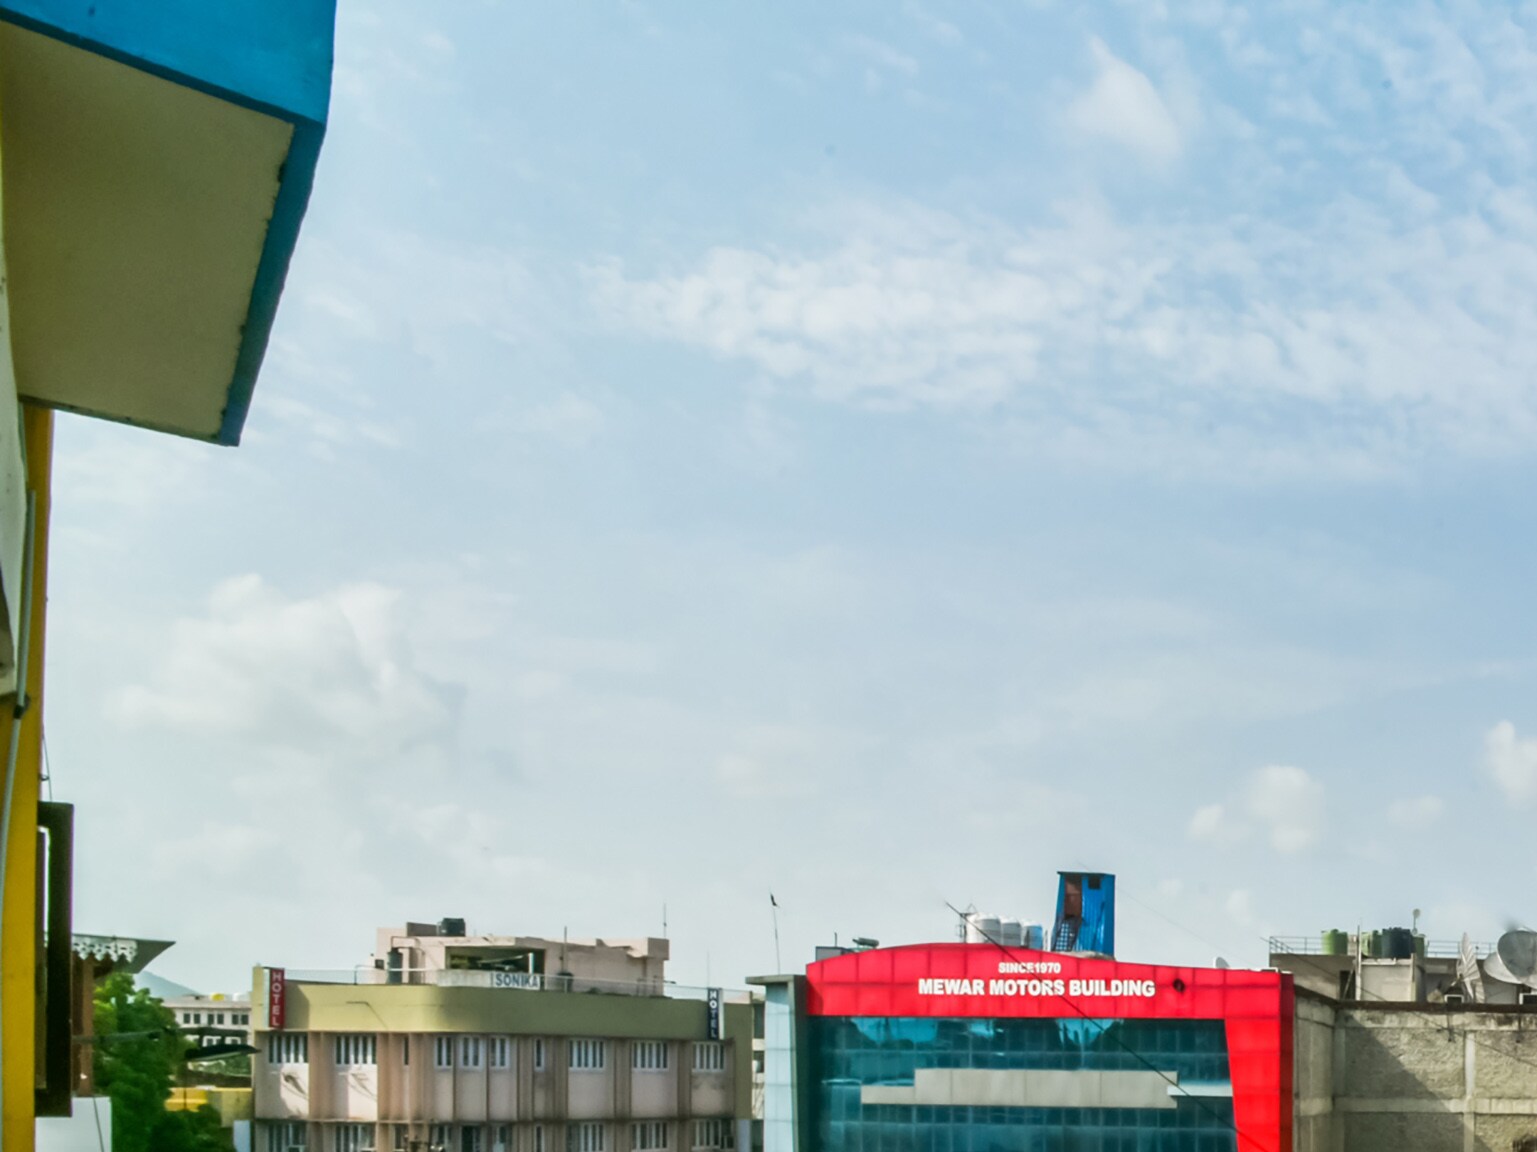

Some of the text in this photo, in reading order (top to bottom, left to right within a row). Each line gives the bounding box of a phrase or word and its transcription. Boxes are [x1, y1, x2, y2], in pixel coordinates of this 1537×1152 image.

[495, 972, 539, 988] SONIKA
[918, 978, 1156, 997] MEWAR MOTORS BUILDING
[271, 970, 283, 1027] HOTEL
[708, 989, 719, 1038] HOTEL
